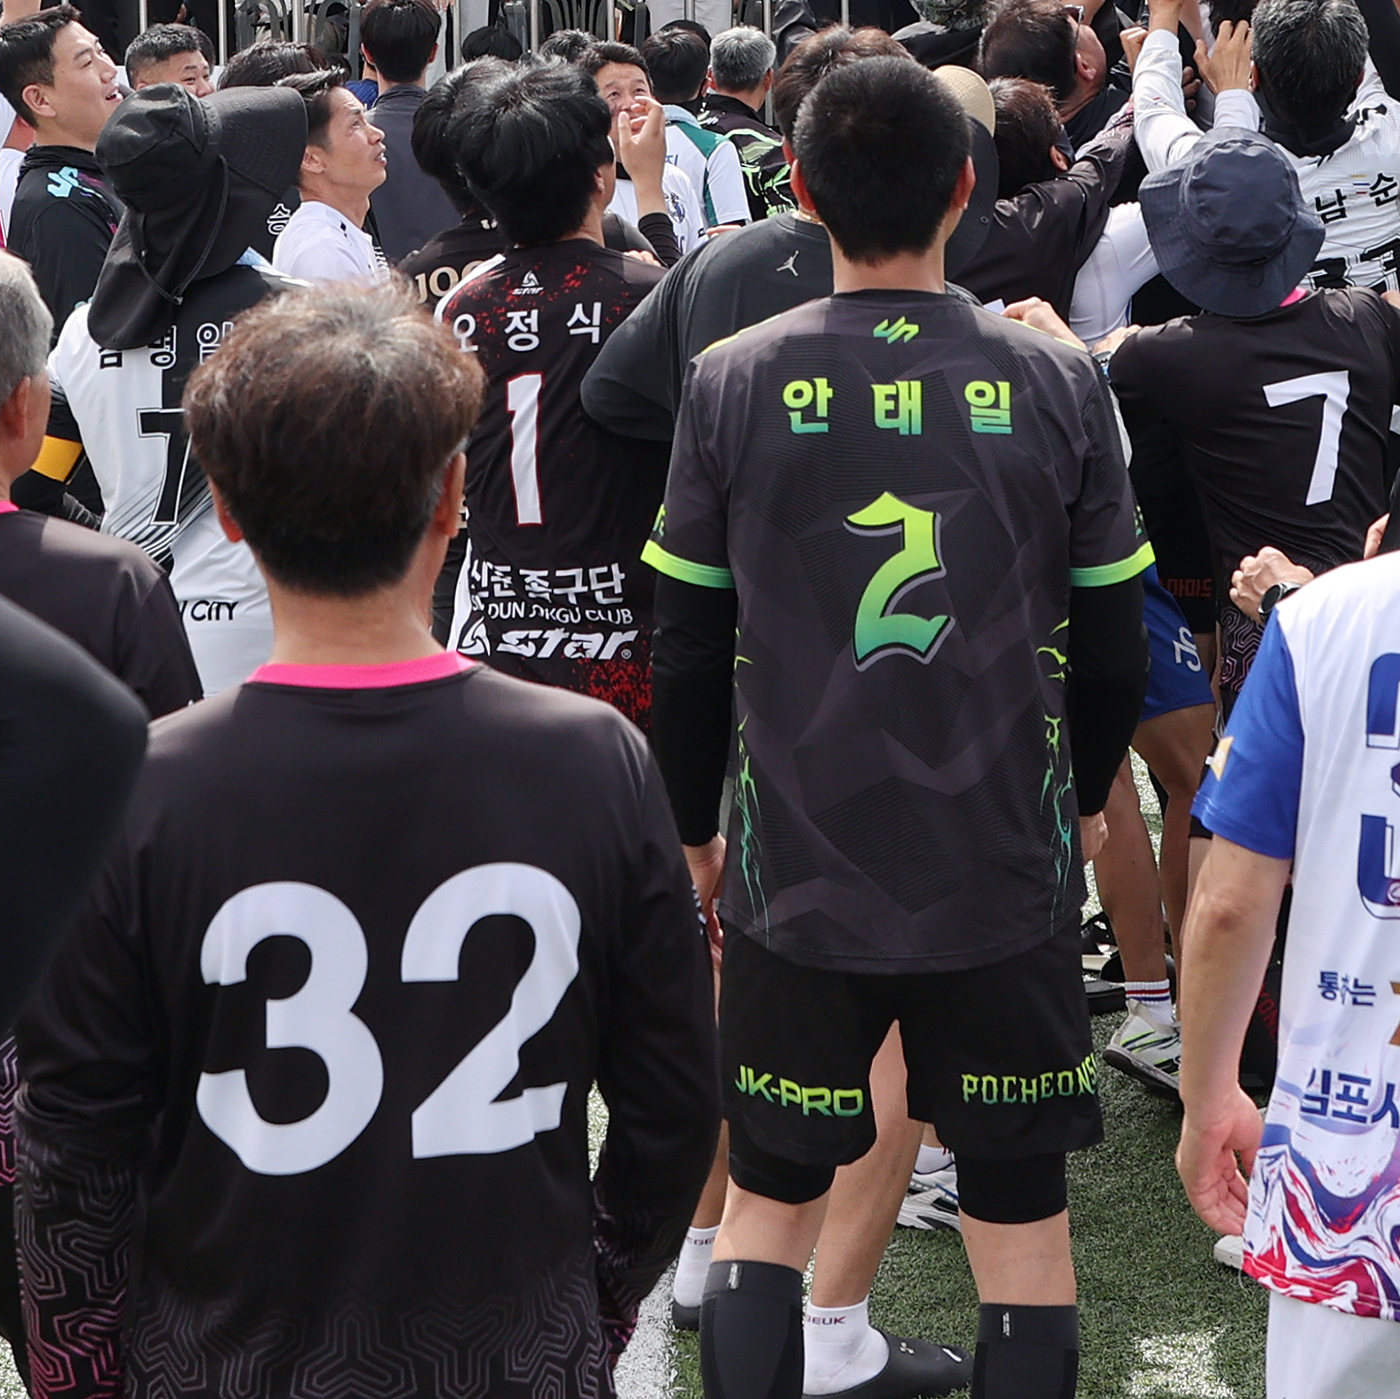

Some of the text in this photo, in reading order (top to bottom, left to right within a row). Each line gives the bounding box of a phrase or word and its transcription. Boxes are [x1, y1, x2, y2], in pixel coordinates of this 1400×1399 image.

[505, 370, 546, 527] 1
[1261, 368, 1351, 508] 7
[190, 599, 240, 622] CITY
[518, 561, 627, 606] 족구단
[843, 490, 955, 673] 2
[196, 860, 582, 1177] 32
[734, 1063, 865, 1119] JK-PRO
